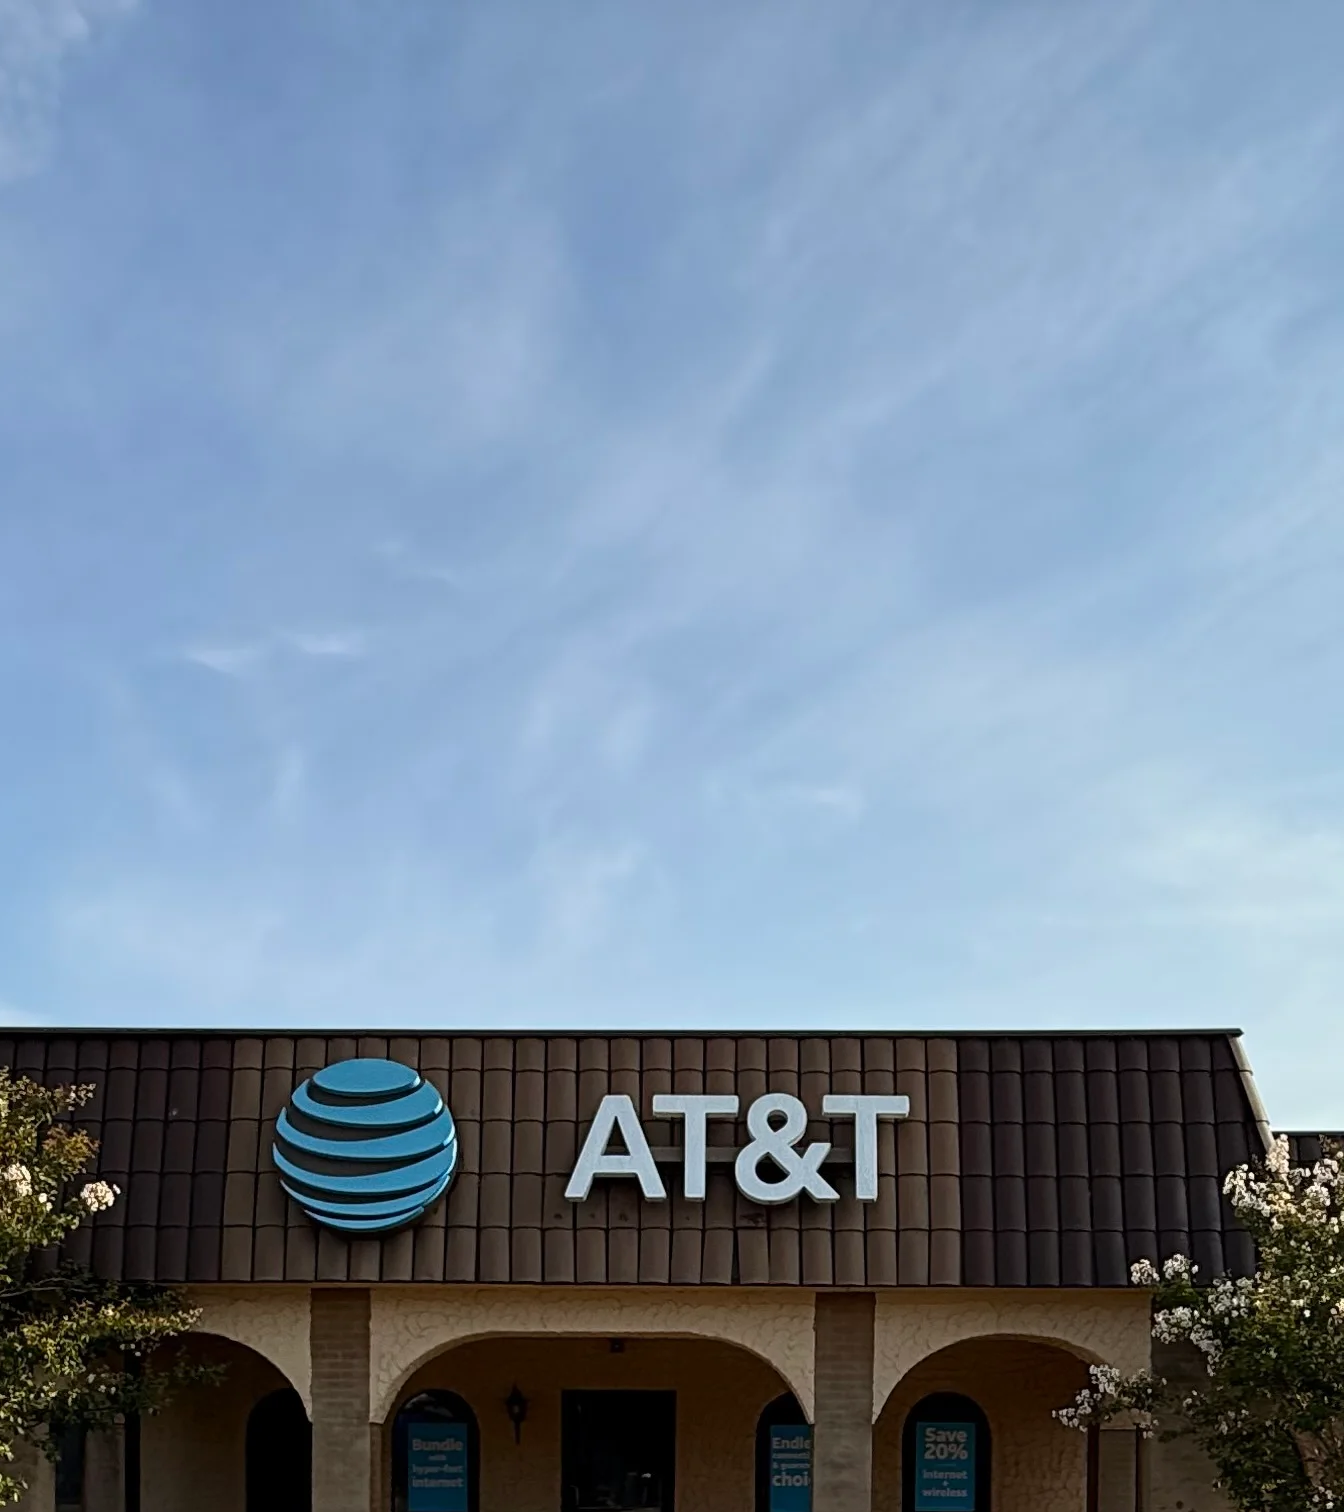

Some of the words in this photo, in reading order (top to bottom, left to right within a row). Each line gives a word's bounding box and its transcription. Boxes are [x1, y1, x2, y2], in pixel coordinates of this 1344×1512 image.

[564, 1093, 910, 1205] AT&T
[924, 1427, 968, 1443] Save
[412, 1437, 464, 1451] Bundle
[923, 1443, 969, 1460] 20%
[411, 1475, 464, 1488] internet
[772, 1471, 811, 1487] choi
[922, 1469, 968, 1480] internet
[921, 1487, 968, 1498] wireless
